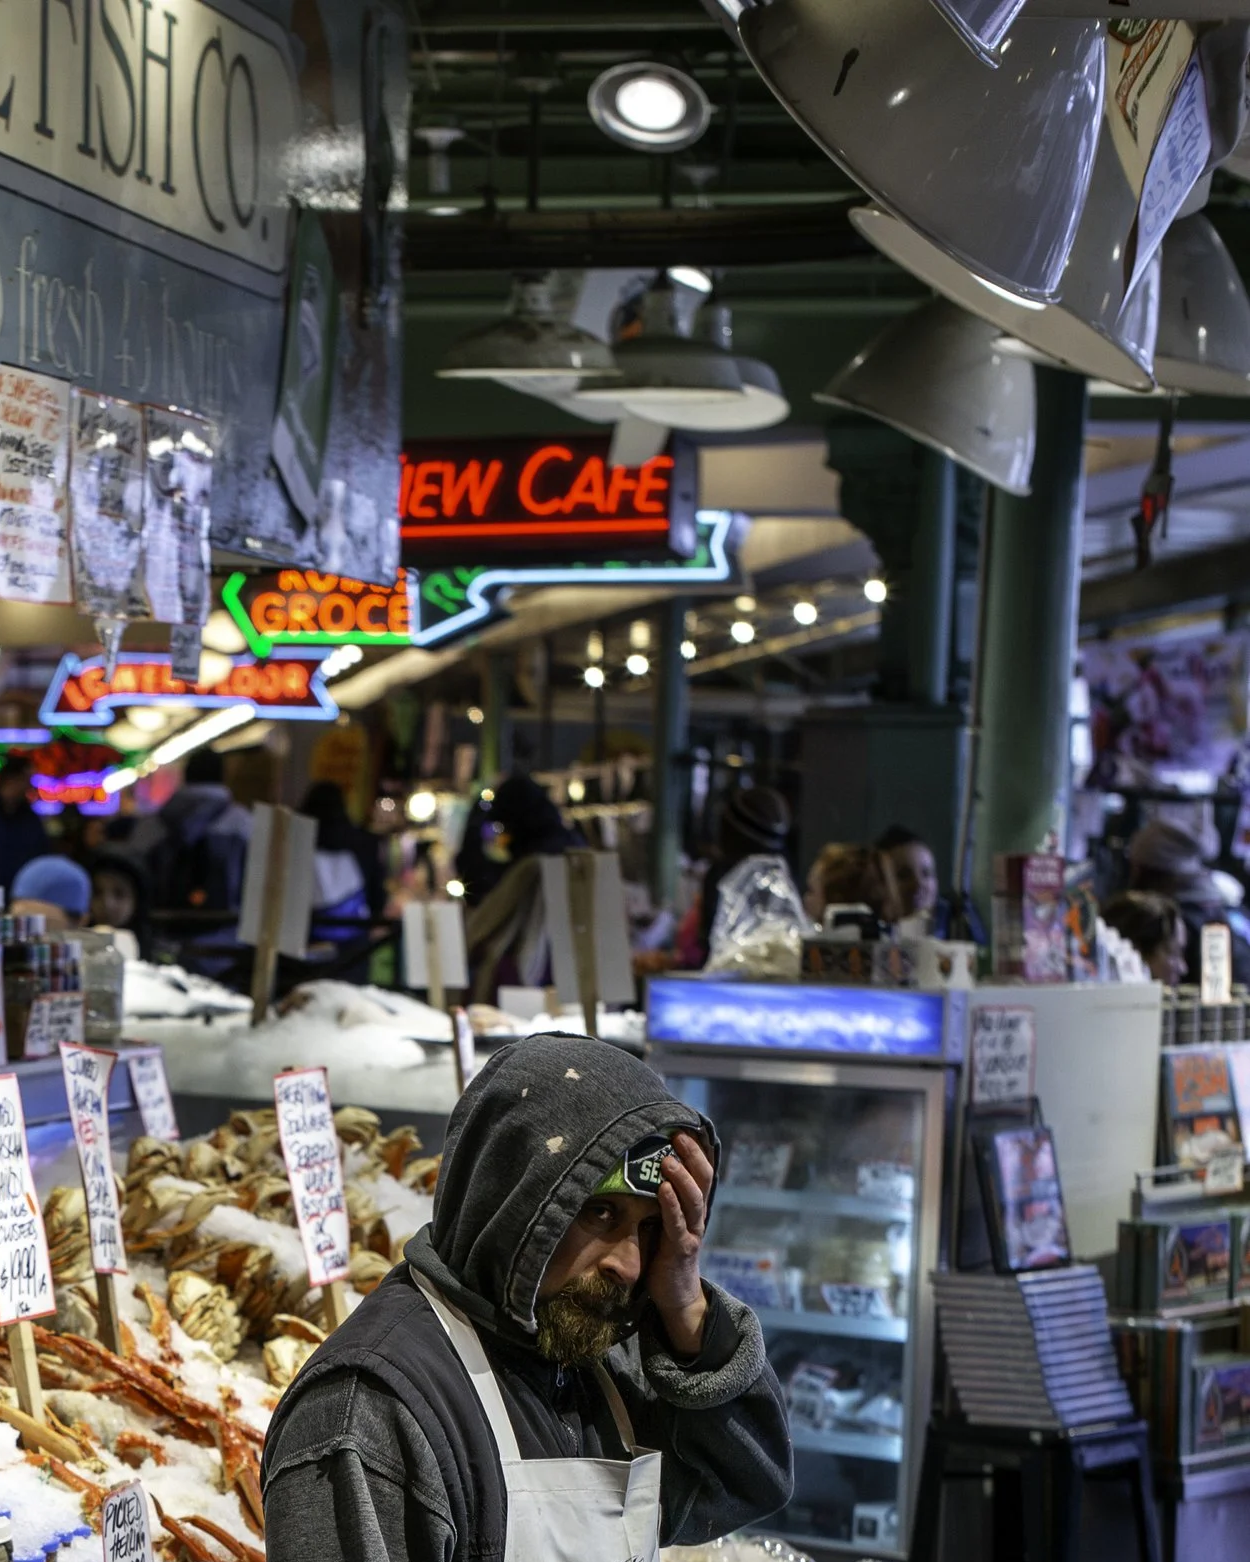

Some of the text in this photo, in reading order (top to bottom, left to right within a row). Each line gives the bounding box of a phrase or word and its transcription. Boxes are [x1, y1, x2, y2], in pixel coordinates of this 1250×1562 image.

[192, 34, 270, 243] CO.
[15, 235, 105, 382] fresh
[399, 444, 674, 518] IEW CAFE
